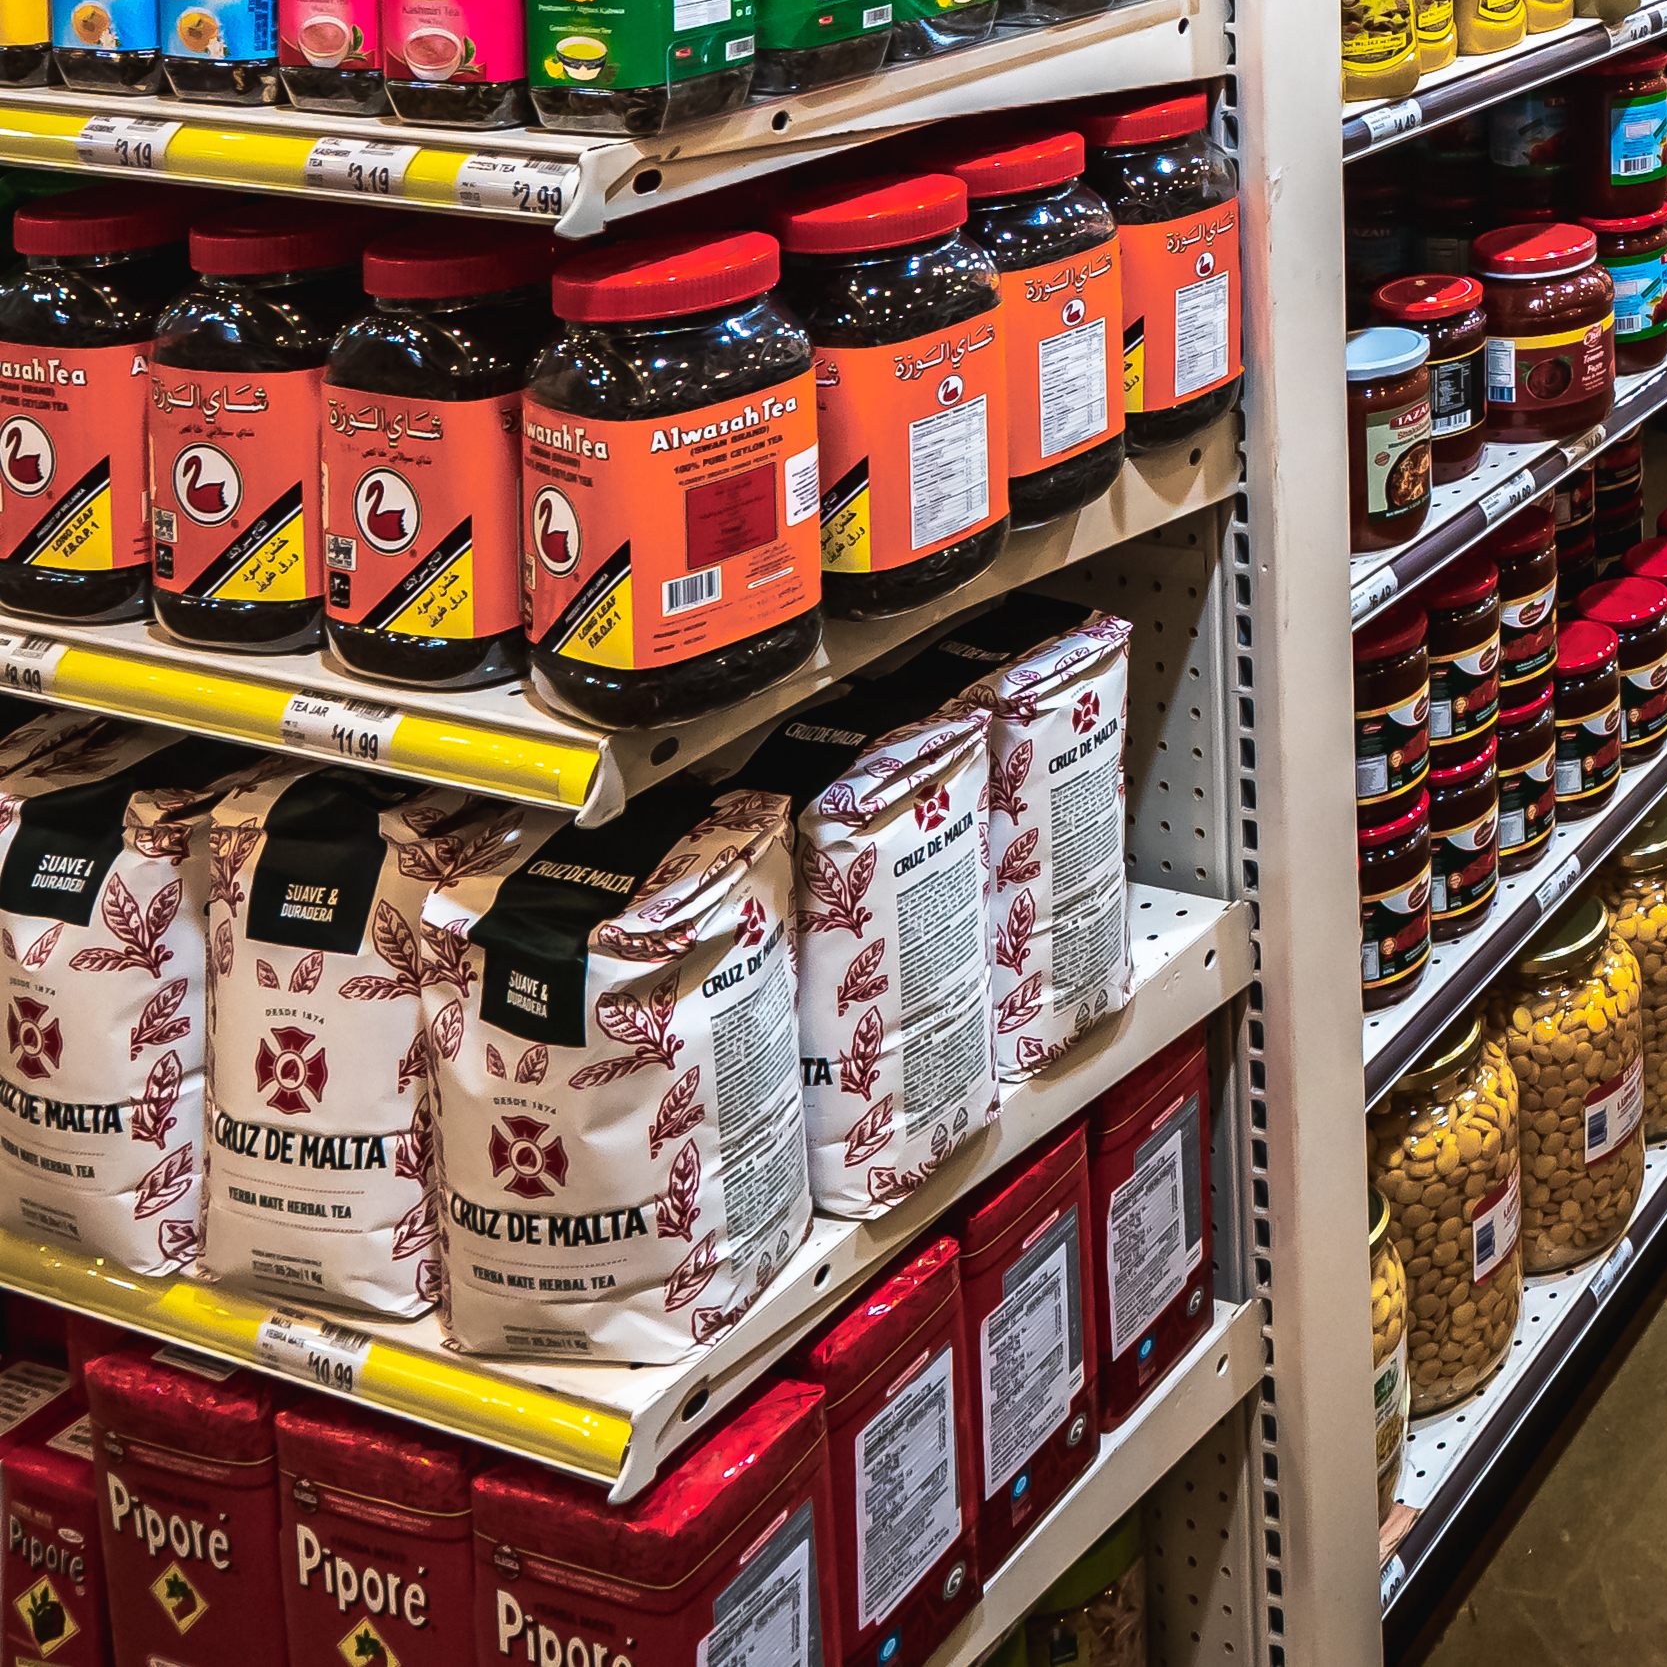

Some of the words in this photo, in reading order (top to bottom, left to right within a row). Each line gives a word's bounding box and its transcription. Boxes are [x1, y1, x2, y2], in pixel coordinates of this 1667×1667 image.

[114, 139, 152, 169] $3.19
[308, 159, 323, 167] TEA
[499, 163, 516, 172] TEA
[347, 161, 389, 194] $3.19
[512, 179, 563, 215] $2.99
[47, 359, 87, 385] Tea
[52, 401, 68, 411] TEA
[651, 406, 760, 454] Alwazah
[762, 397, 797, 422] Tea
[575, 427, 609, 460] Tea
[703, 454, 727, 466] PURE
[730, 442, 765, 458] CEYLON
[767, 435, 783, 446] TEA
[51, 528, 73, 552] LONG
[72, 507, 95, 530] LEAF
[597, 595, 617, 618] LEAF
[291, 700, 311, 712] TEA
[312, 704, 329, 718] JAR
[331, 723, 379, 761] $11.99
[1048, 746, 1078, 775] CRUZ
[1078, 738, 1094, 758] DE
[1093, 716, 1119, 750] MALTA
[892, 849, 926, 879] CRUZ
[927, 838, 944, 859] DE
[943, 811, 974, 852] MALTA
[38, 855, 86, 876] SUAVE
[527, 860, 569, 880] CRUZ
[569, 866, 588, 884] DE
[588, 872, 637, 894] MALTA
[286, 883, 325, 904] SUAVE
[328, 888, 338, 904] &
[280, 902, 333, 923] DURADERA
[509, 970, 540, 996] SUAVE
[540, 983, 548, 1002] &
[702, 964, 745, 1000] CRUZ
[748, 952, 762, 975] DE
[265, 1007, 297, 1019] DESDE
[507, 990, 549, 1020] DURADERA
[17, 1100, 42, 1127] DE
[45, 1104, 123, 1135] MALTA
[214, 1111, 259, 1160] CRUZ
[265, 1130, 296, 1163] DE
[300, 1134, 387, 1172] MALTA
[76, 1165, 96, 1179] TEA
[228, 1186, 256, 1207] YERBA
[260, 1192, 285, 1213] MATE
[288, 1196, 328, 1217] HERBAL
[331, 1204, 352, 1220] TEA
[450, 1194, 502, 1242] CRUZ
[507, 1209, 543, 1246] DE
[546, 1206, 648, 1248] MALTA
[472, 1265, 505, 1286] YERBA
[508, 1272, 537, 1290] MATE
[538, 1272, 586, 1293] HERBAL
[590, 1273, 617, 1292] TEA
[106, 1470, 232, 1572] Piporé
[9, 1513, 86, 1584] Piporé
[296, 1523, 429, 1629] Piporé
